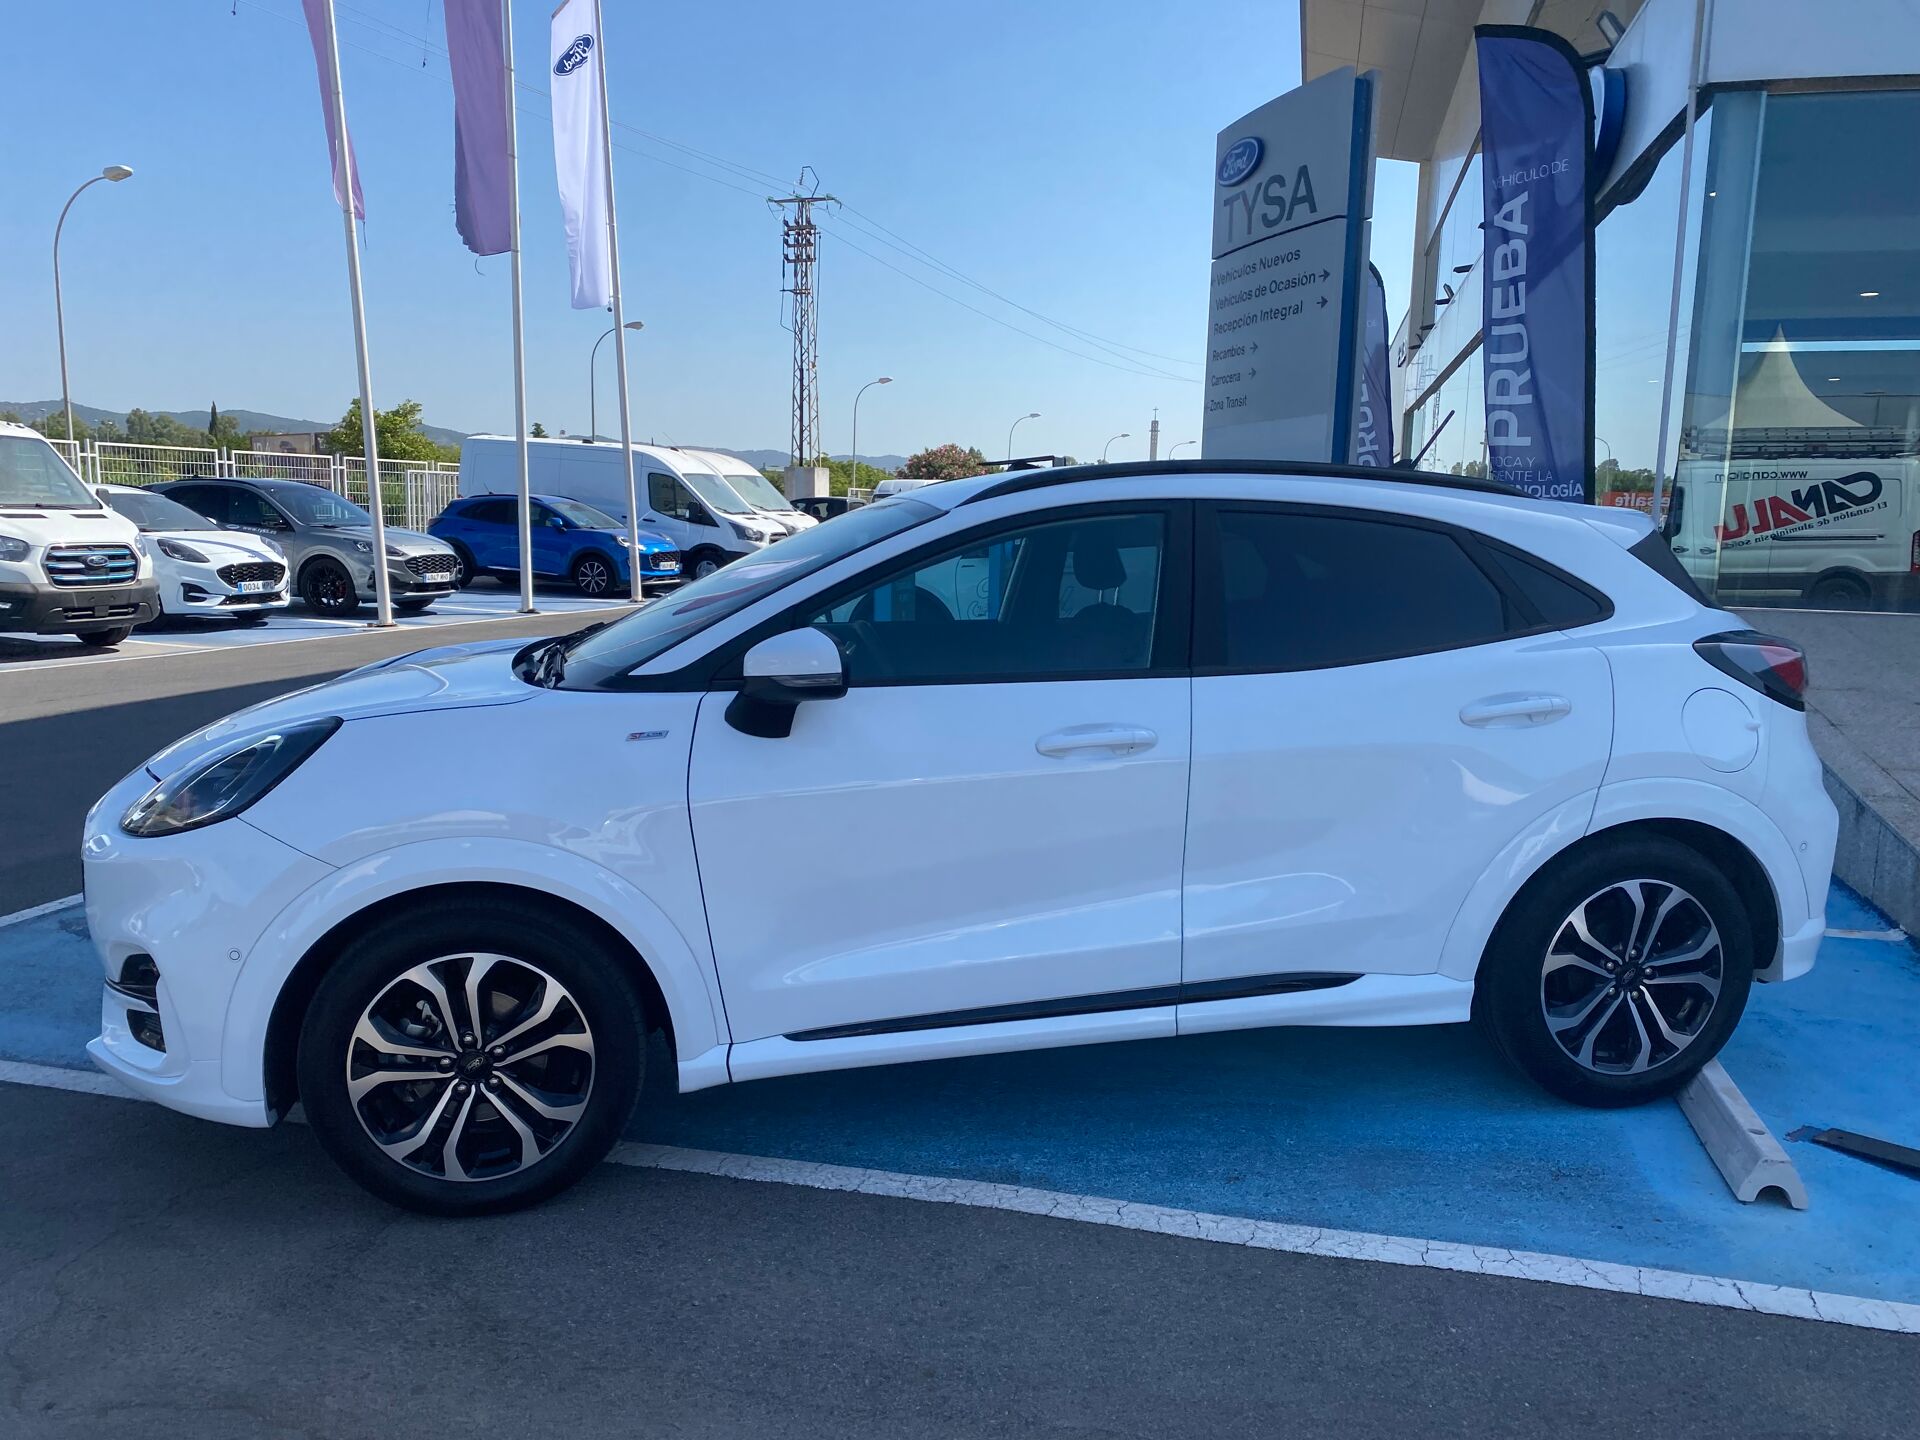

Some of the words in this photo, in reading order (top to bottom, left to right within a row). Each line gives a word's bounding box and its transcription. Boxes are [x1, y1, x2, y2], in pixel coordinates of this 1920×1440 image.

[1551, 158, 1569, 174] DE
[1223, 164, 1318, 242] TYSA
[1259, 249, 1301, 271] Nuevos
[1254, 284, 1267, 298] de
[1269, 271, 1316, 294] Ocasión
[1213, 312, 1258, 336] Recepción
[1259, 299, 1303, 321] Integral
[1486, 190, 1533, 447] PRUEBA
[1526, 456, 1536, 468] Y
[1537, 470, 1553, 482] LA
